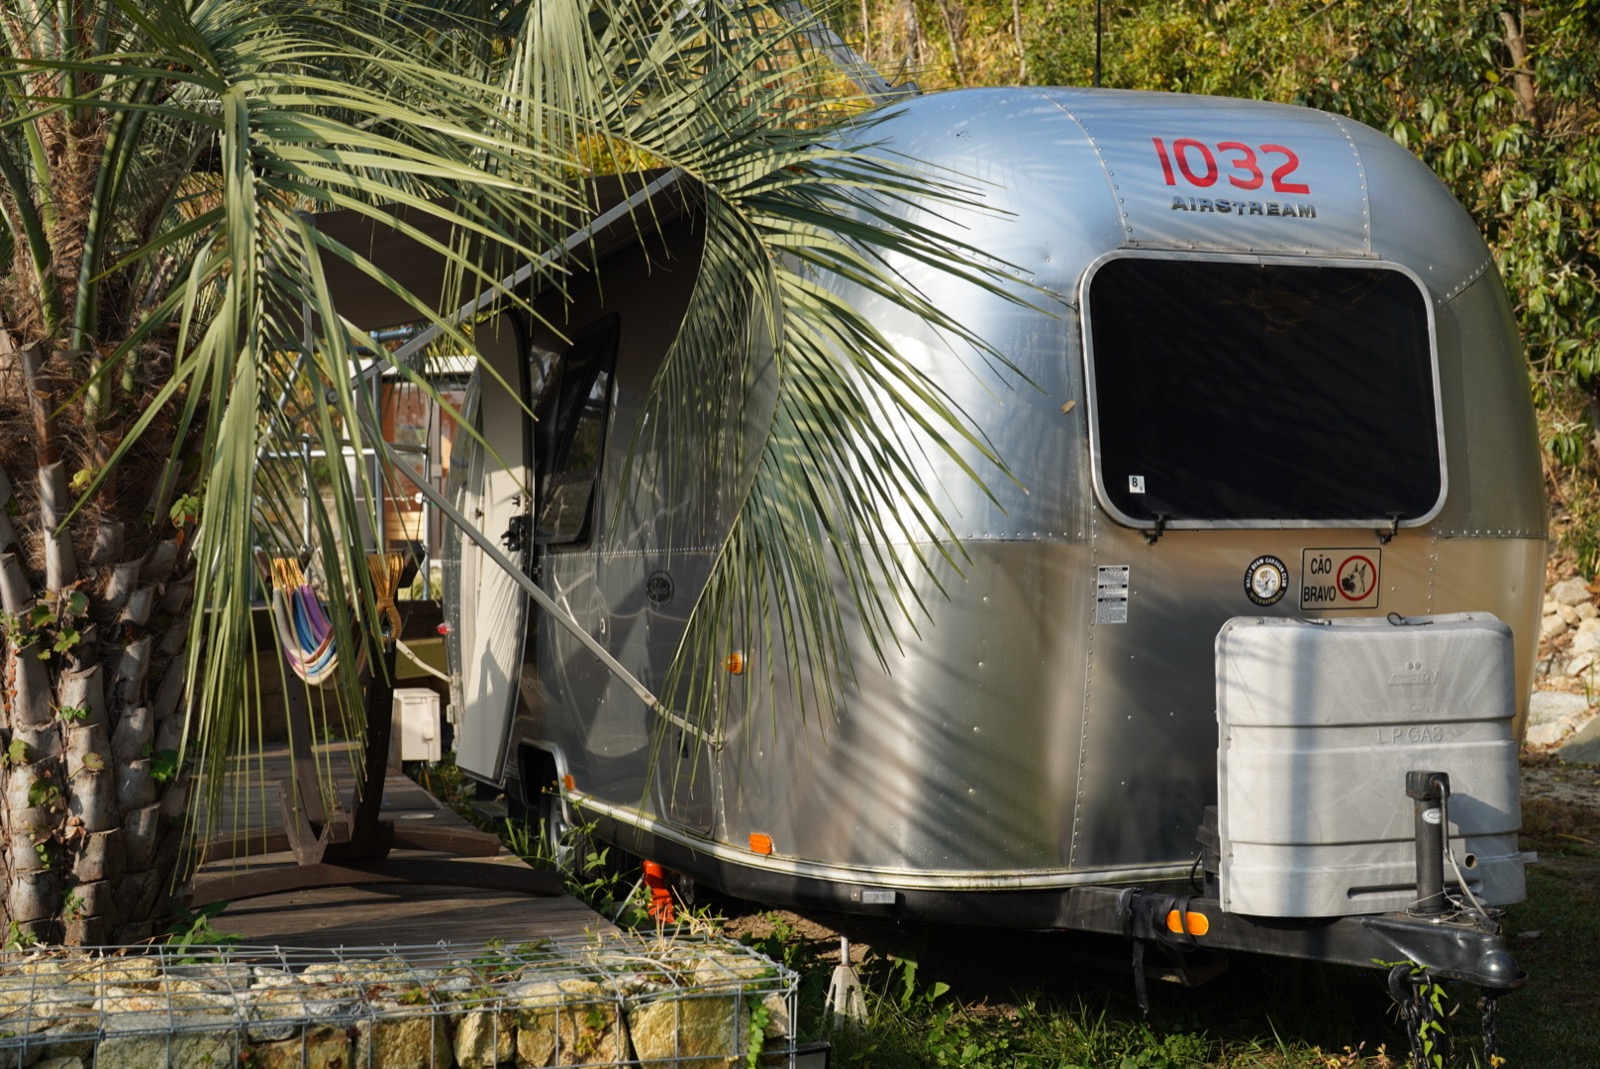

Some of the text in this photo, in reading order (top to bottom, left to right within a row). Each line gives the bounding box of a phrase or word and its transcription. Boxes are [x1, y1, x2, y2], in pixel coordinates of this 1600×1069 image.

[1152, 137, 1310, 194] 1032
[1171, 196, 1316, 218] AIRSTREAM
[1132, 477, 1138, 488] 8
[1311, 554, 1332, 574] CÃO
[1303, 585, 1336, 602] BRAVO
[1407, 726, 1443, 743] GAS
